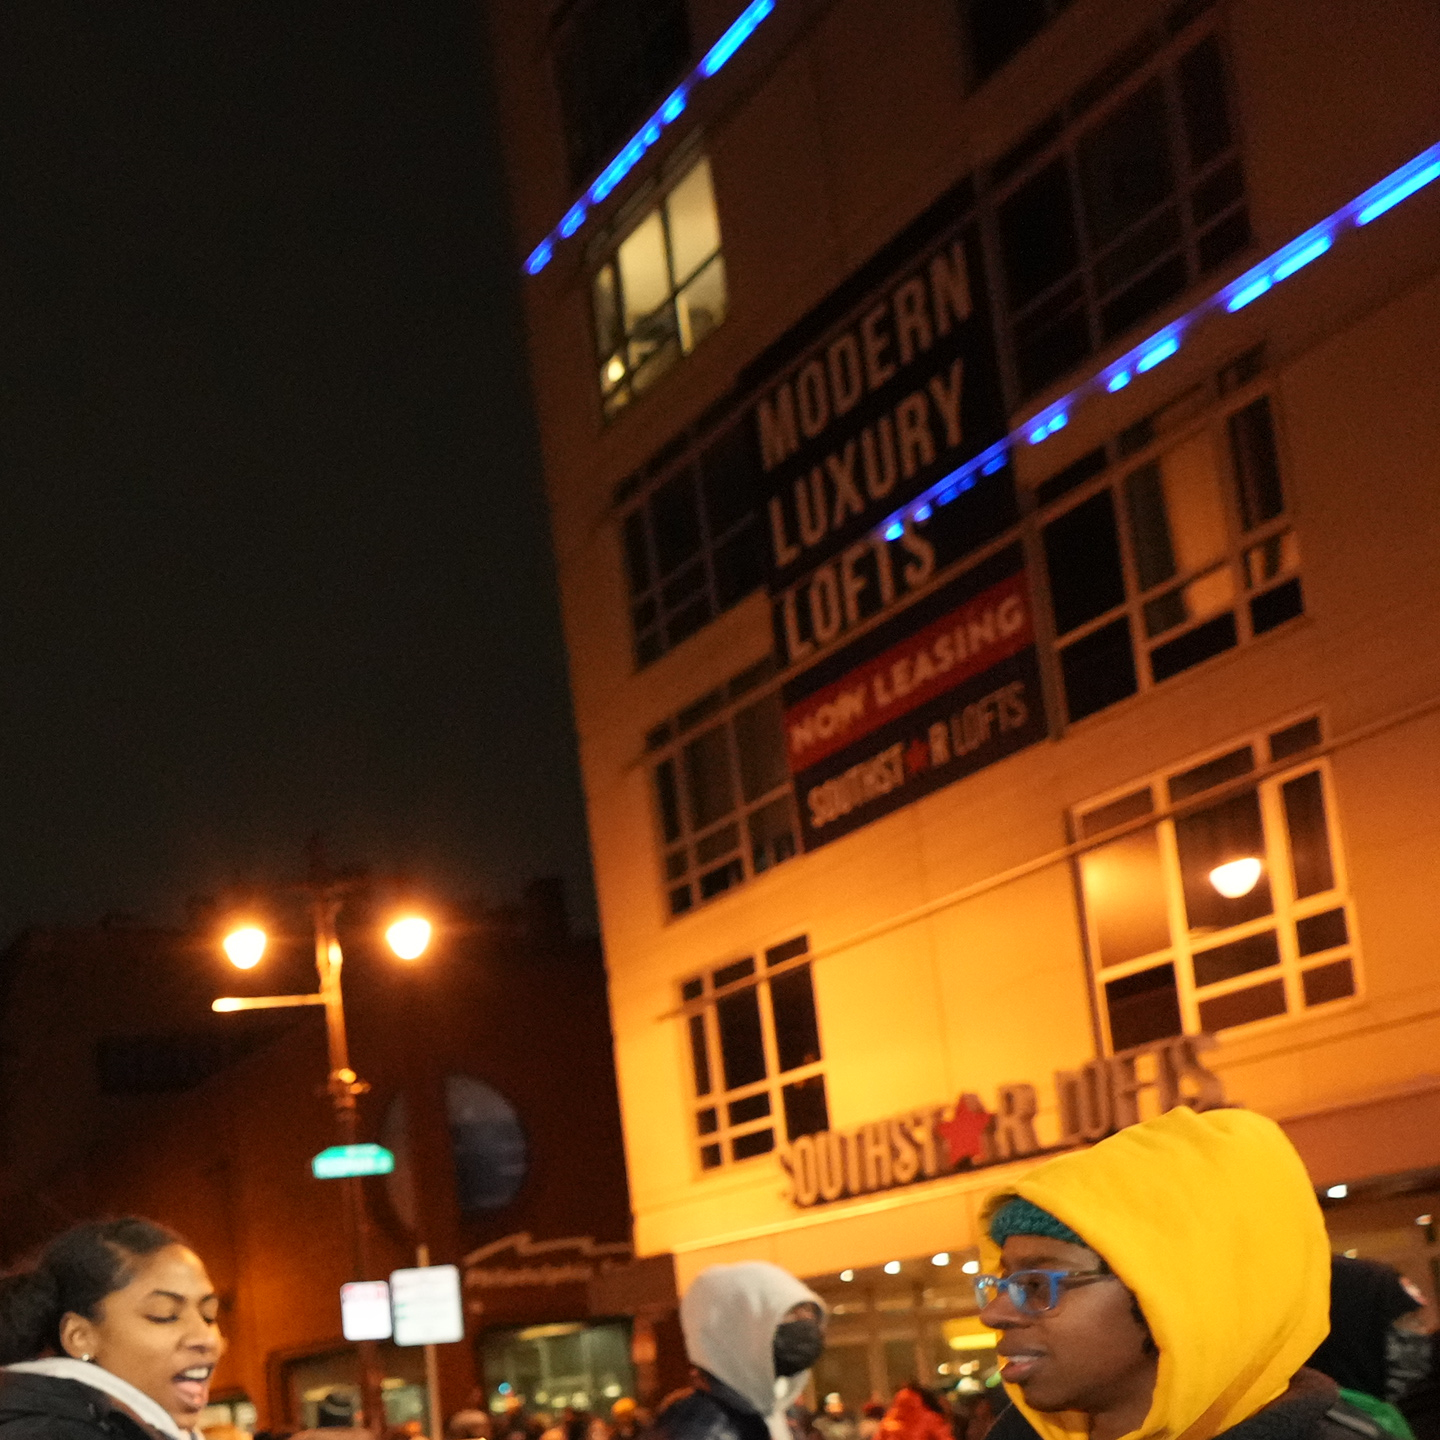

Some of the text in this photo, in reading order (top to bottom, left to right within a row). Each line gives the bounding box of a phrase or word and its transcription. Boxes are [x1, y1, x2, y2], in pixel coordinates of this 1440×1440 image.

[758, 242, 973, 472] MODERN
[769, 357, 964, 568] LUXURY
[783, 525, 936, 662] LOFTS
[789, 595, 1024, 752] NOW LEASING
